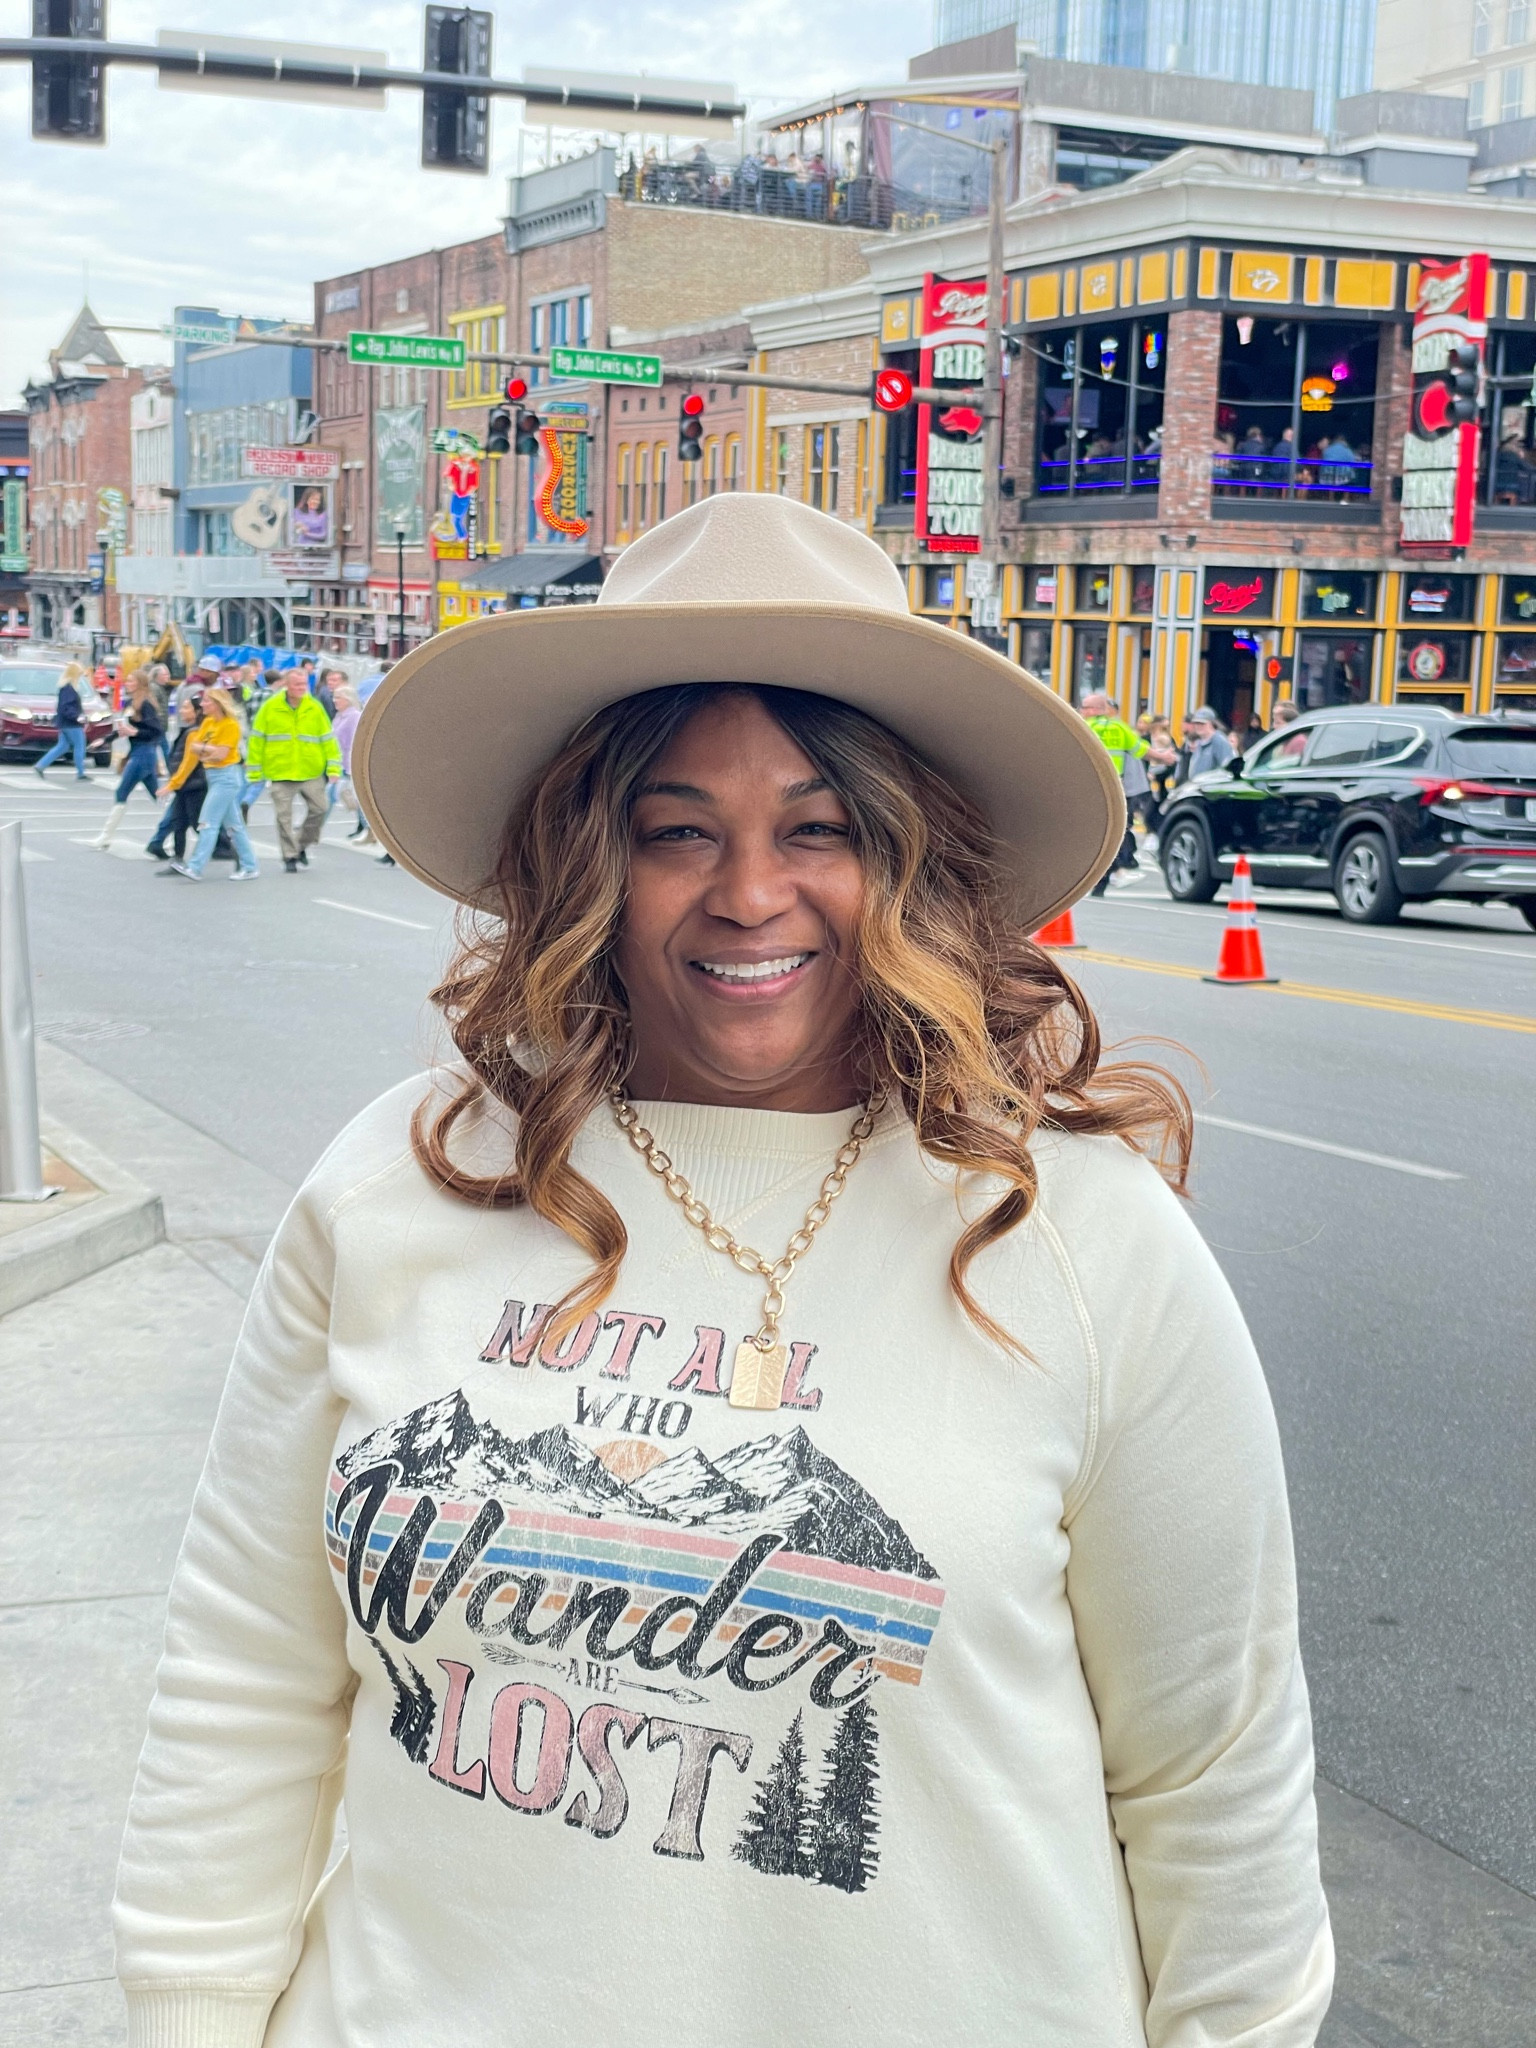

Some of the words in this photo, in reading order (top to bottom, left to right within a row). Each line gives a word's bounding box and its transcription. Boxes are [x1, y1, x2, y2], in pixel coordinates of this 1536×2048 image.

[176, 327, 230, 343] PARKING
[387, 339, 409, 357] John
[410, 341, 437, 360] Lewis
[574, 353, 595, 372] John
[596, 356, 621, 374] Lewis
[636, 360, 644, 379] S
[933, 344, 985, 380] RIB
[254, 462, 297, 477] RECORD
[303, 464, 329, 478] SHOP
[561, 431, 577, 521] MUSHROOM
[927, 504, 982, 536] TON
[478, 1299, 667, 1383] NOT
[668, 1325, 824, 1412] AL
[576, 1385, 693, 1440] WHO
[334, 1460, 877, 1711] Wander
[565, 1657, 620, 1695] ARE
[428, 1658, 754, 1863] LOST
